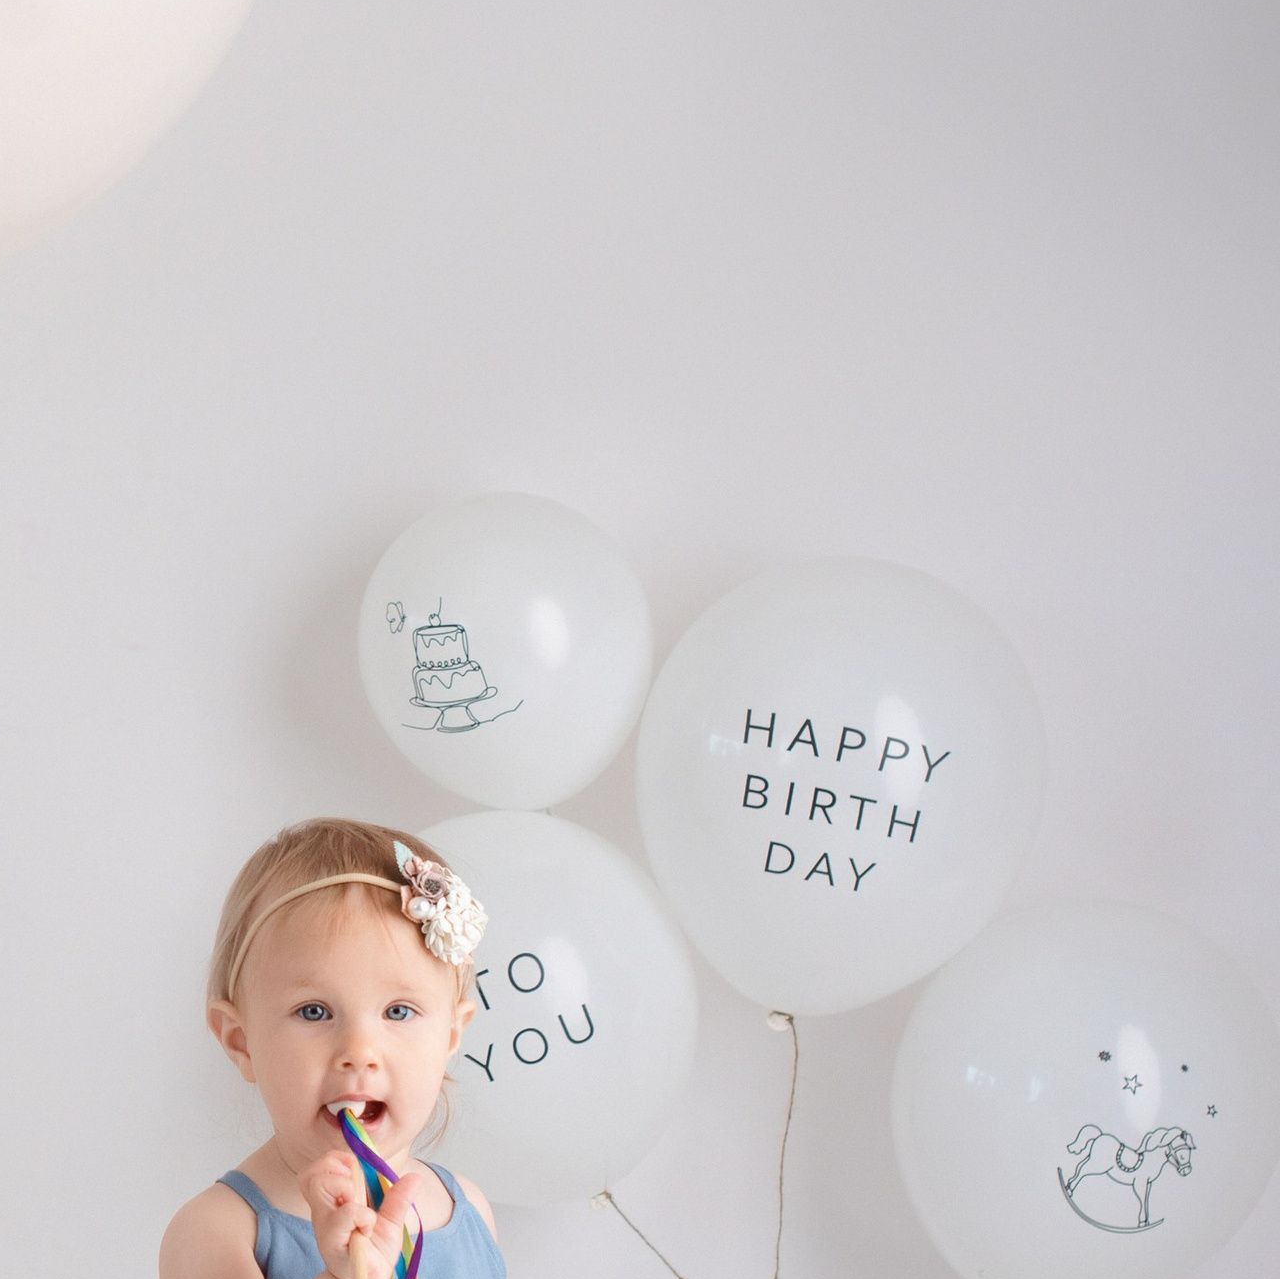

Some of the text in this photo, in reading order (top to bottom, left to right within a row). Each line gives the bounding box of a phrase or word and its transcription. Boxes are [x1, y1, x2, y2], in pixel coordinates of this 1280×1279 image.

[742, 707, 953, 784] HAPPY
[741, 772, 922, 844] BIRTH
[763, 840, 878, 893] DAY
[463, 1003, 596, 1084] YOU
